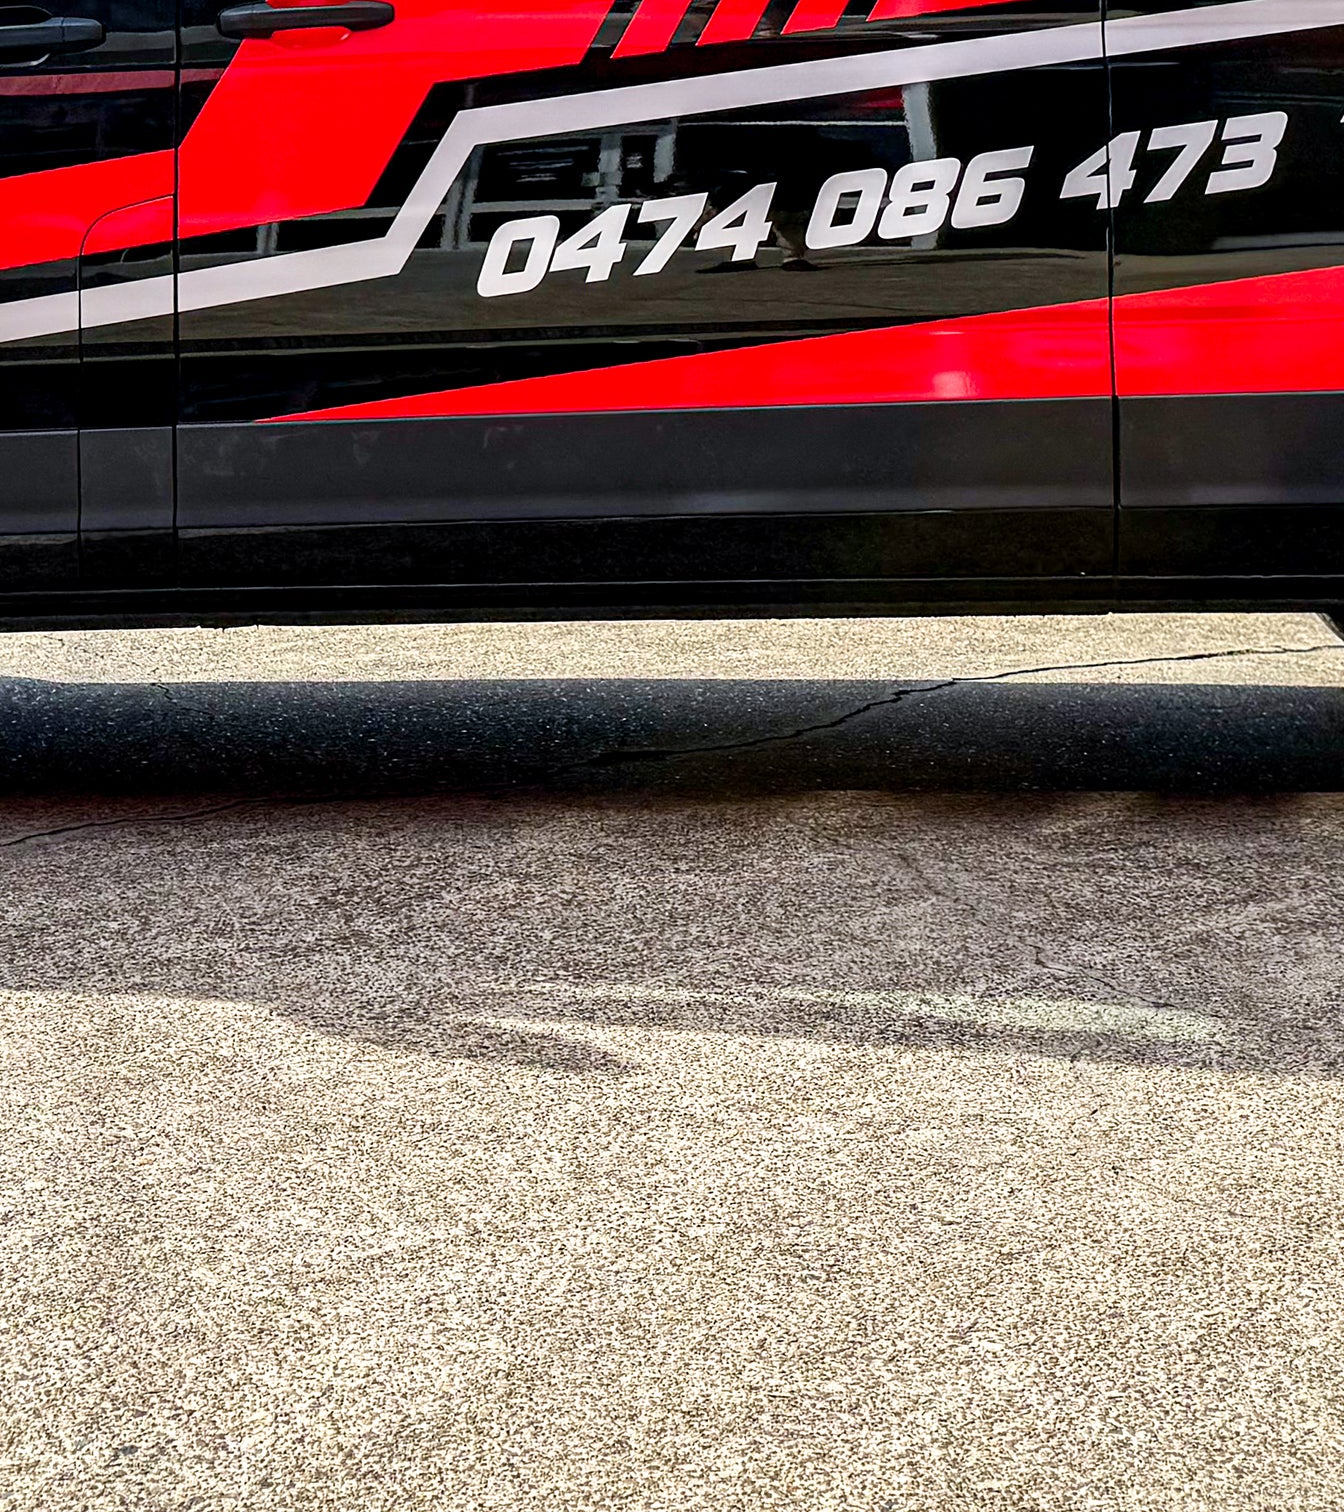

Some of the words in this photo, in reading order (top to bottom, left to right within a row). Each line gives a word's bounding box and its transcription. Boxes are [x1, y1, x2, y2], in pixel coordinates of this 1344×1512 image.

[475, 183, 778, 298] 0474
[805, 146, 1034, 251] 086
[1060, 111, 1289, 211] 473
